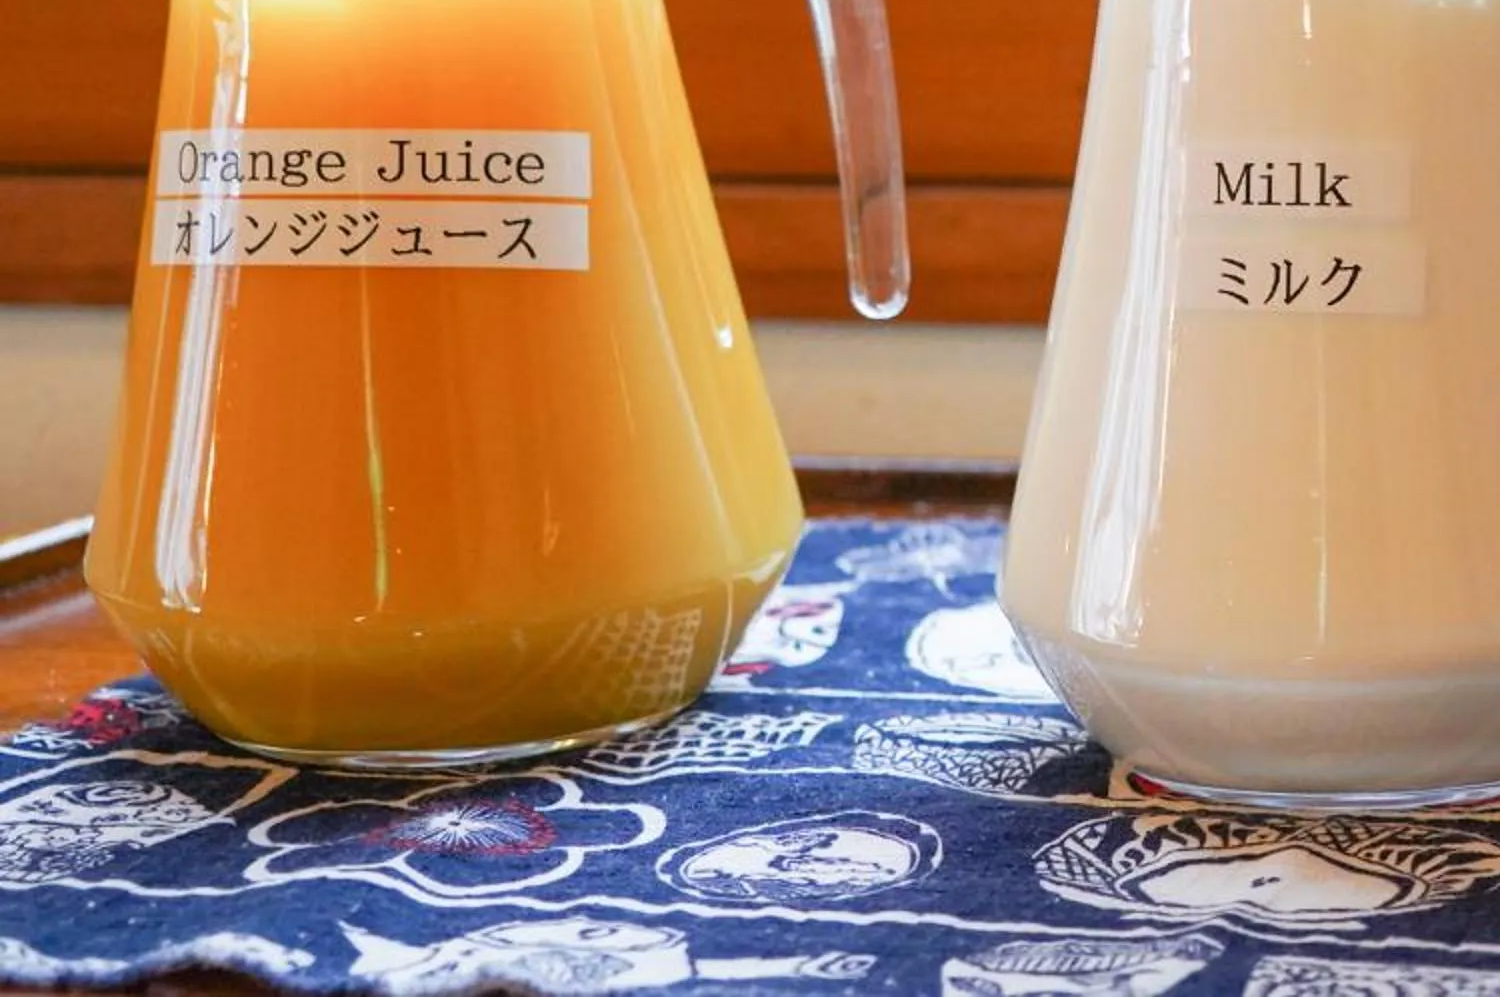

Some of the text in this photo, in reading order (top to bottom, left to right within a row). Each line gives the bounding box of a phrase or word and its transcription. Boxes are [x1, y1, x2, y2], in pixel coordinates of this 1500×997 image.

[178, 139, 546, 187] Orange Juice
[1213, 162, 1353, 207] Milk
[175, 210, 538, 260] オレンジジュース
[1217, 255, 1363, 306] ミルク
